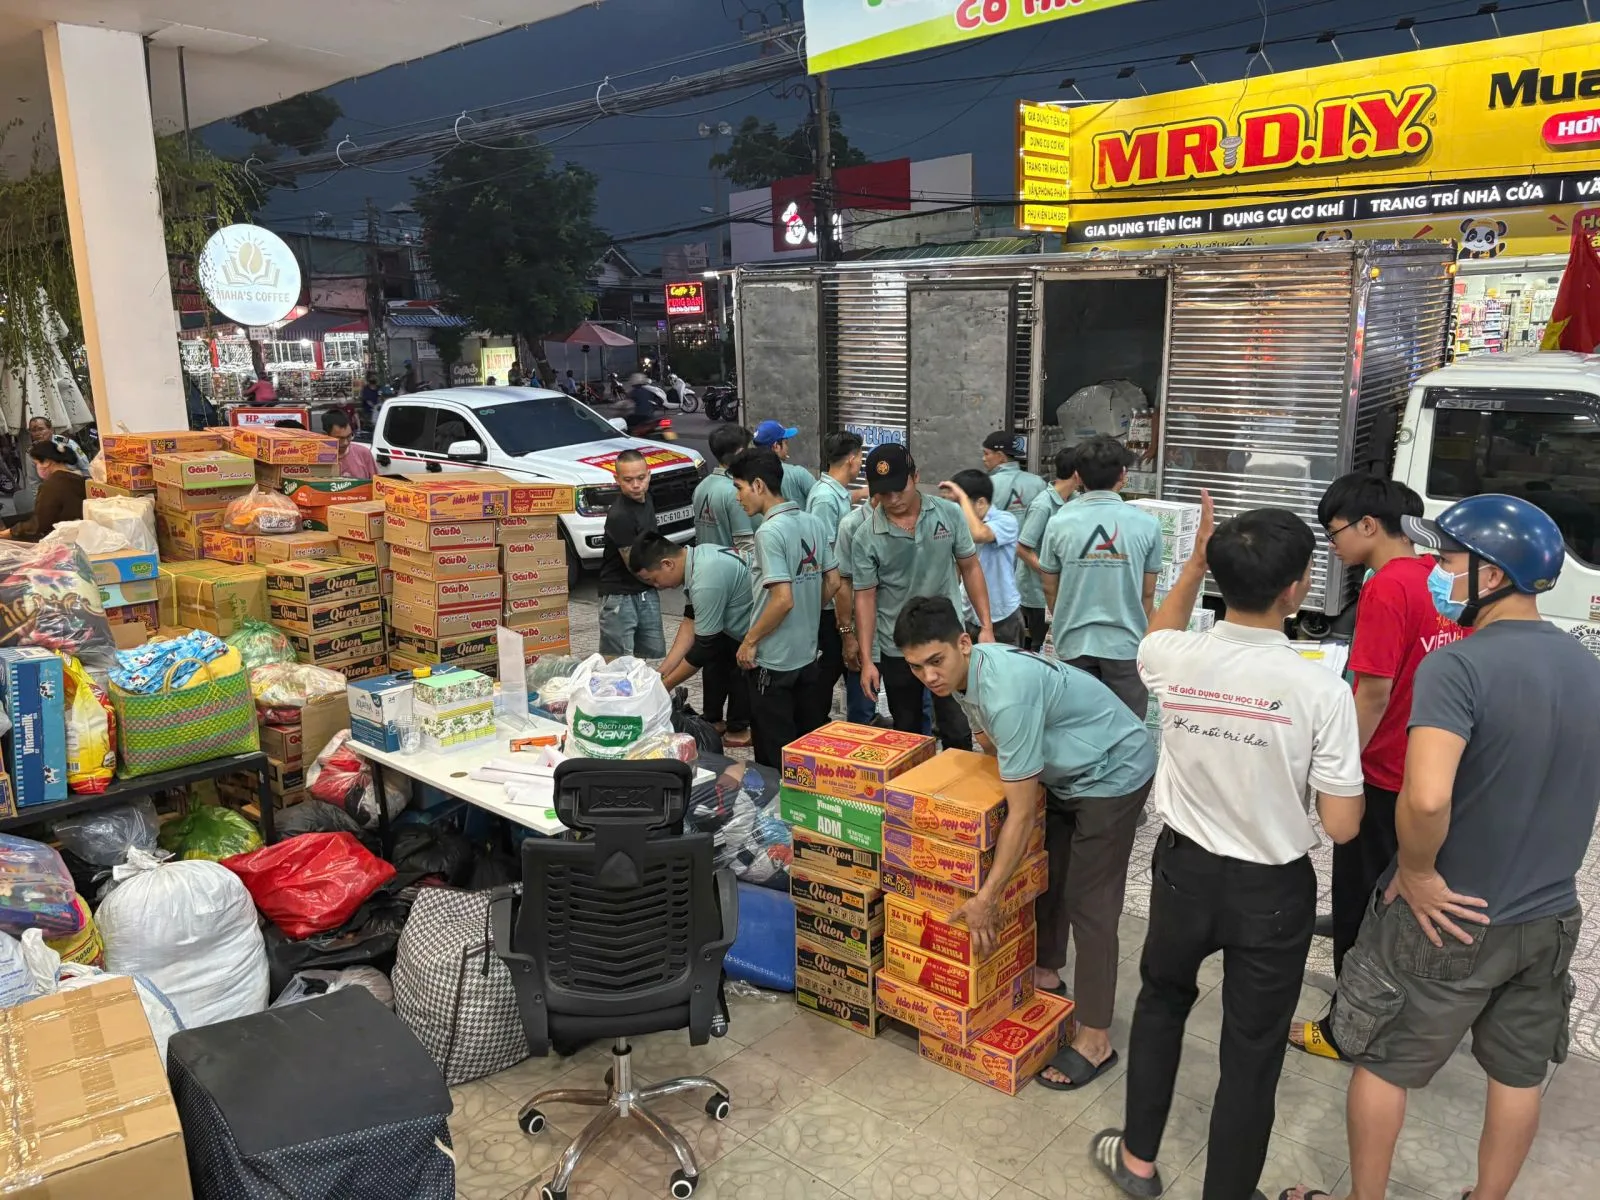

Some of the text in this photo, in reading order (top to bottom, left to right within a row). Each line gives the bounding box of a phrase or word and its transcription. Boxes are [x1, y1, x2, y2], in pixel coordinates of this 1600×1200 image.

[1370, 182, 1544, 212] TRANG TRÍ NHÀ CỬA
[1224, 200, 1345, 227] DỤNG CỤ CƠ KHÍ
[1084, 216, 1202, 238] GIA DỤNG TIỆN ÍCH
[216, 290, 290, 302] MAHA'S COFFEE
[433, 527, 449, 536] Gấu
[438, 556, 456, 564] Gấu
[442, 586, 459, 594] Gấu
[1168, 684, 1269, 708] THẾ GIỚI DỤNG CỤ HỌC TẬP
[23, 712, 35, 755] Vinamilk
[595, 730, 632, 739] XANH
[818, 815, 842, 839] ADM
